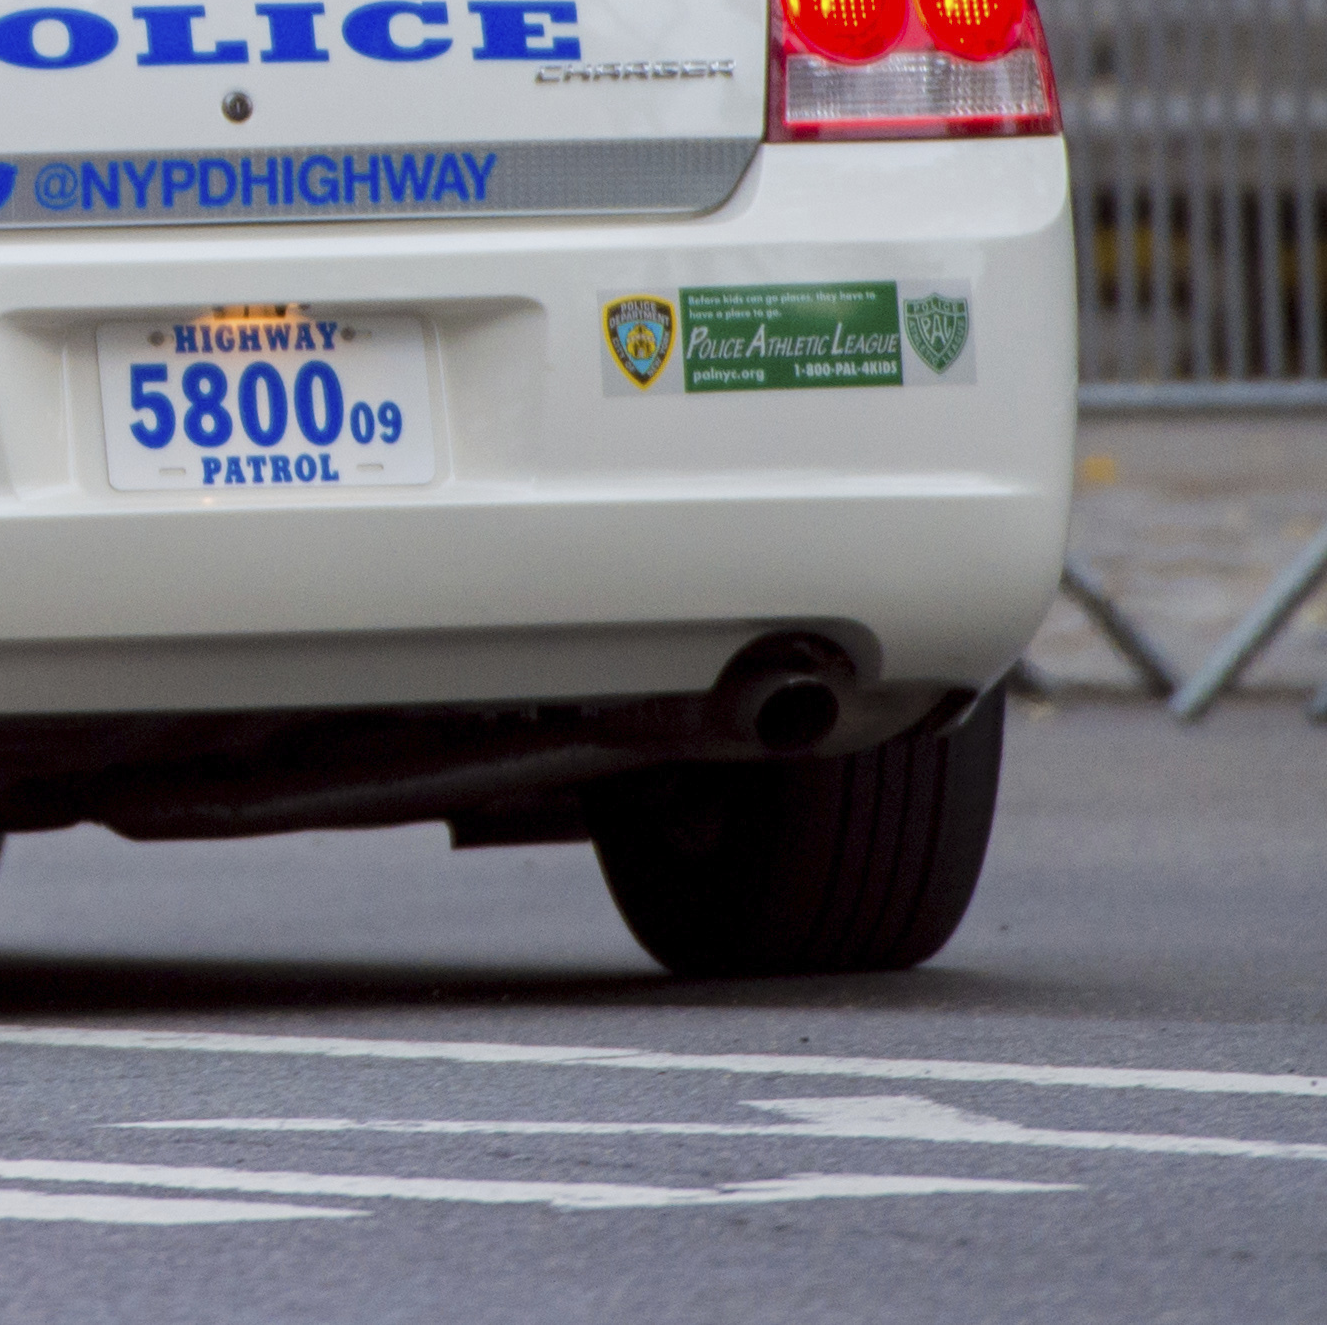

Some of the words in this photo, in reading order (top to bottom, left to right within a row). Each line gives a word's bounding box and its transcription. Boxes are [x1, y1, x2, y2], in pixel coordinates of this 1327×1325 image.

[535, 59, 737, 84] CHARGER
[34, 152, 498, 211] @NYPDHIGHWAY
[689, 308, 714, 319] have
[725, 307, 751, 320] place
[753, 308, 764, 318] to
[723, 293, 743, 304] kids
[746, 295, 763, 304] can
[765, 295, 779, 305] go
[815, 291, 837, 304] they
[839, 291, 863, 301] have
[865, 291, 876, 301] to
[173, 321, 338, 354] HIGHWAY
[686, 325, 745, 360] POLICE
[744, 323, 830, 358] ATHLETIC
[831, 322, 899, 356] LEAGUE
[920, 314, 952, 345] PAL
[693, 367, 765, 383] palnyc.org
[201, 453, 339, 485] PATROL
